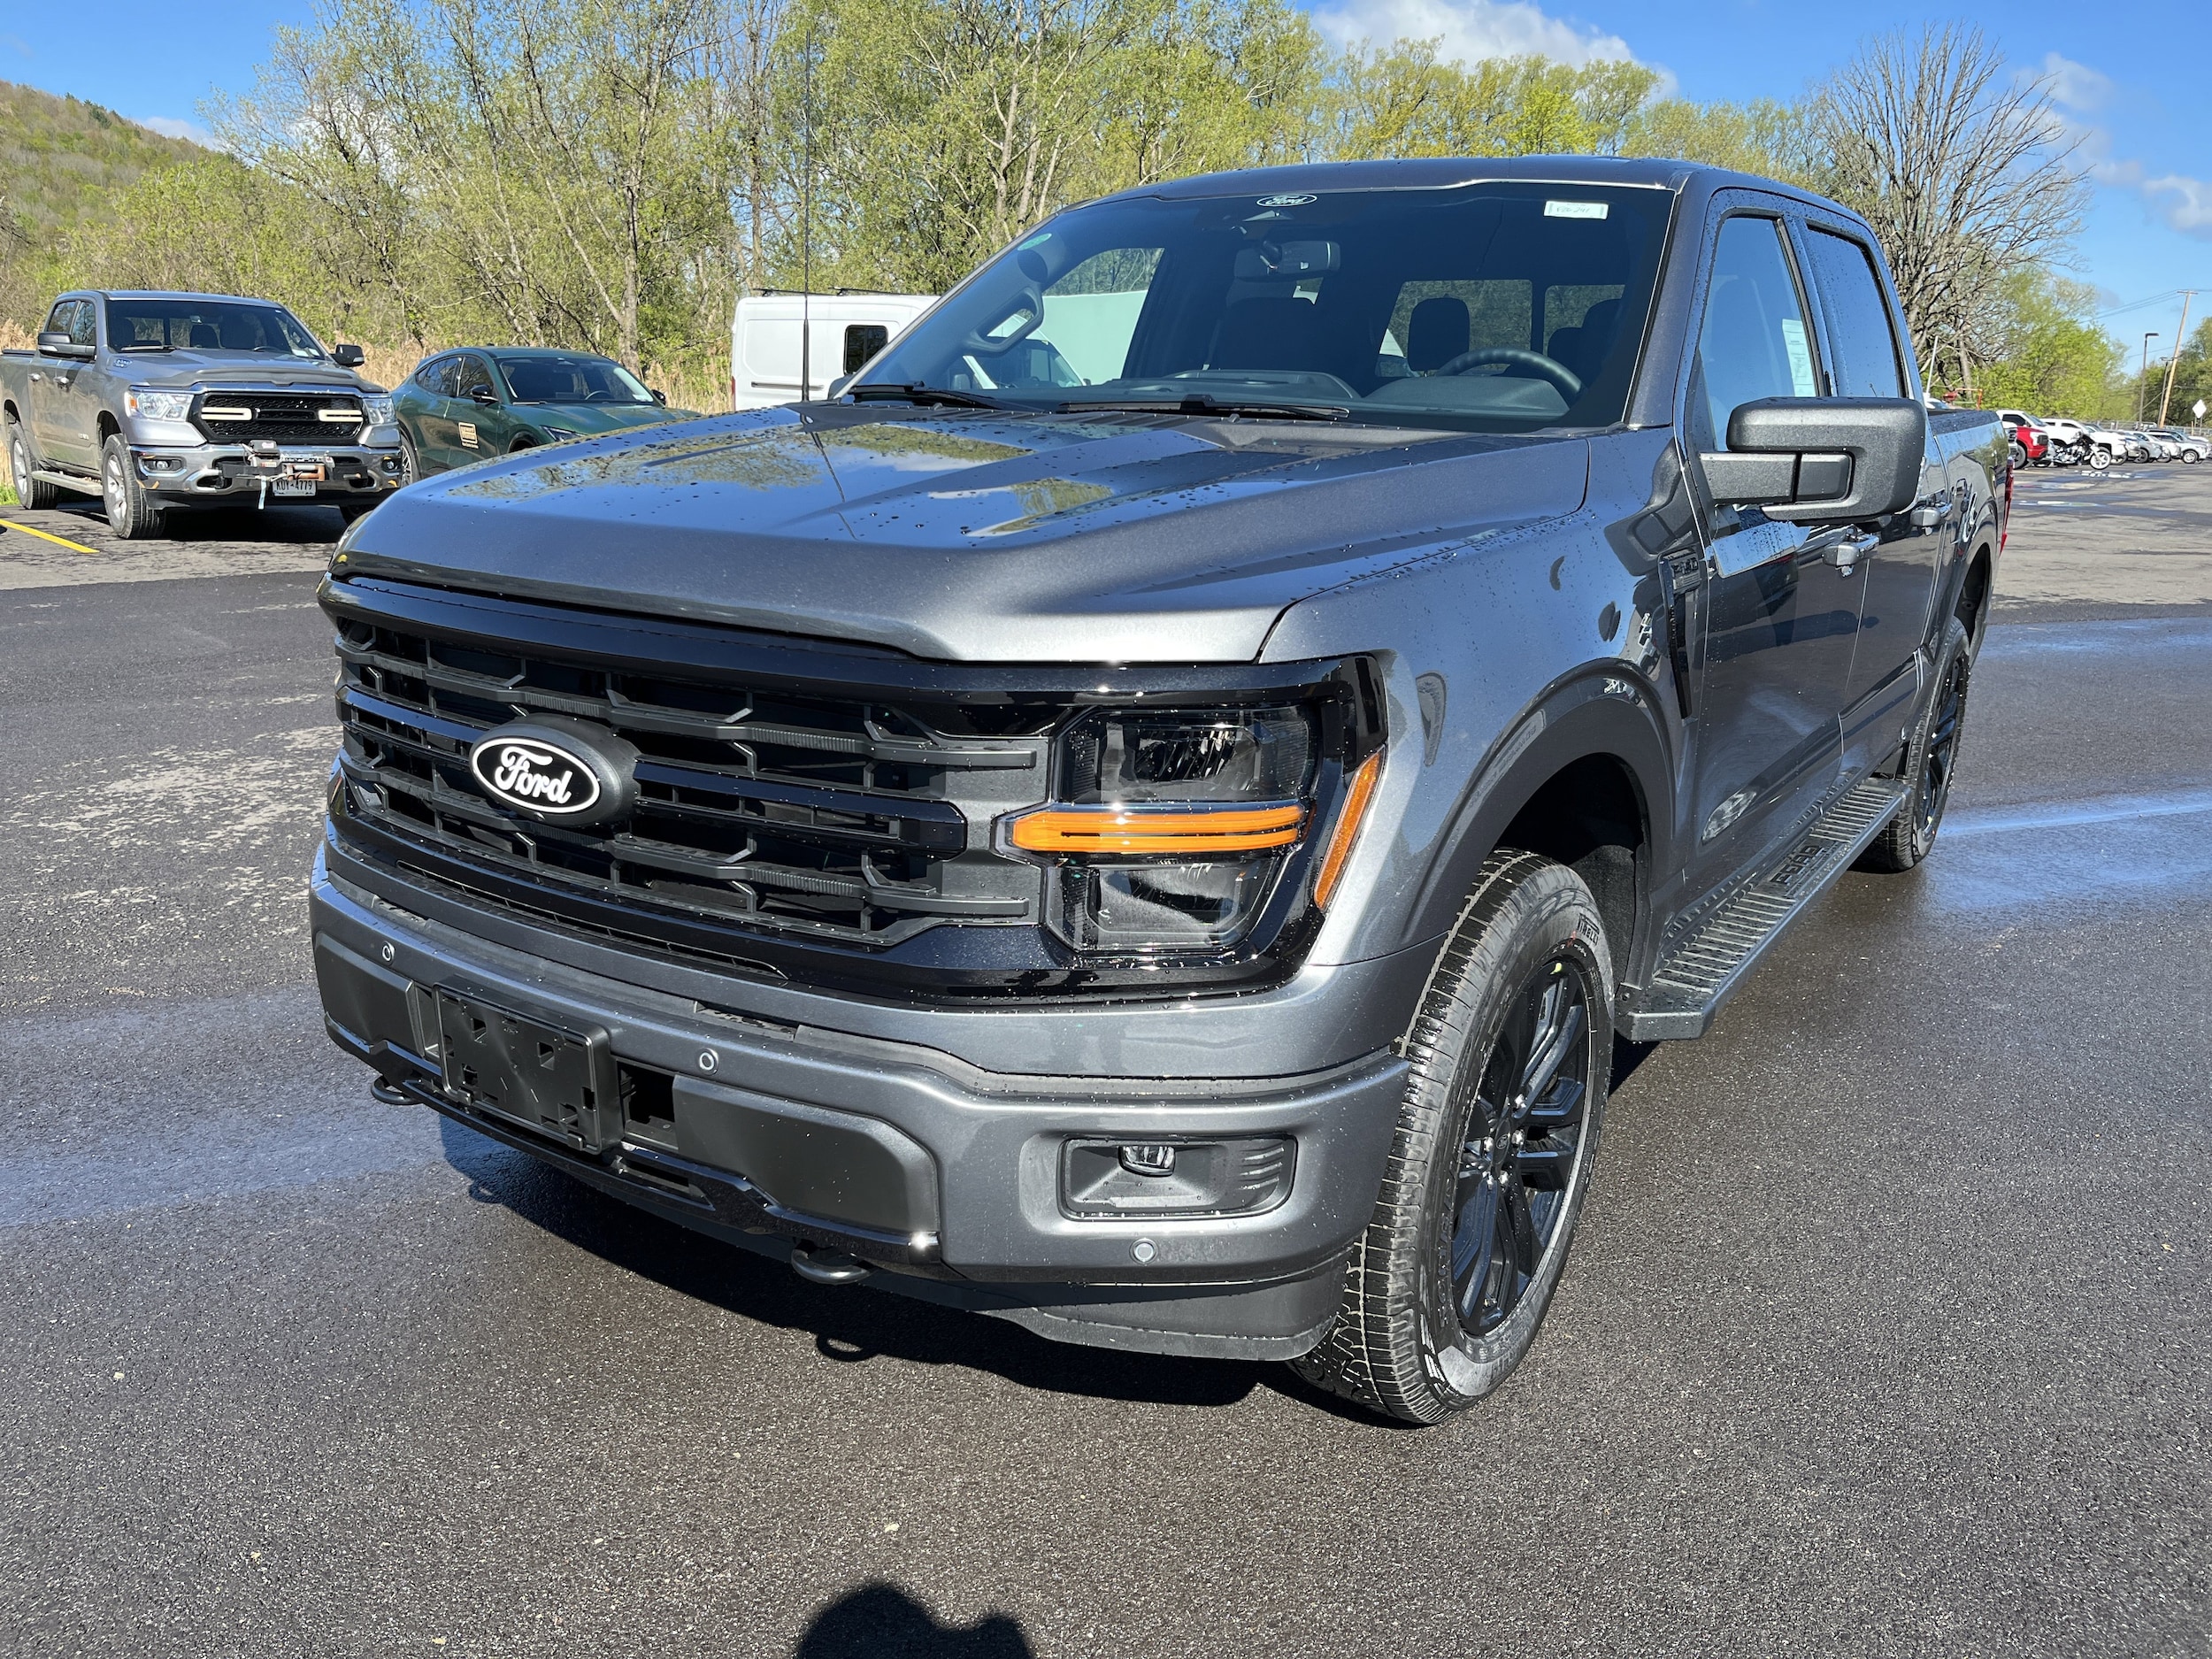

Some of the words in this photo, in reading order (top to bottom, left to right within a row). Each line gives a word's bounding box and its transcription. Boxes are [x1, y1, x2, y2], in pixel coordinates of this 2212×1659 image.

[295, 480, 313, 491] 4779
[494, 745, 573, 804] Ford
[1577, 912, 1601, 947] PIRELLI
